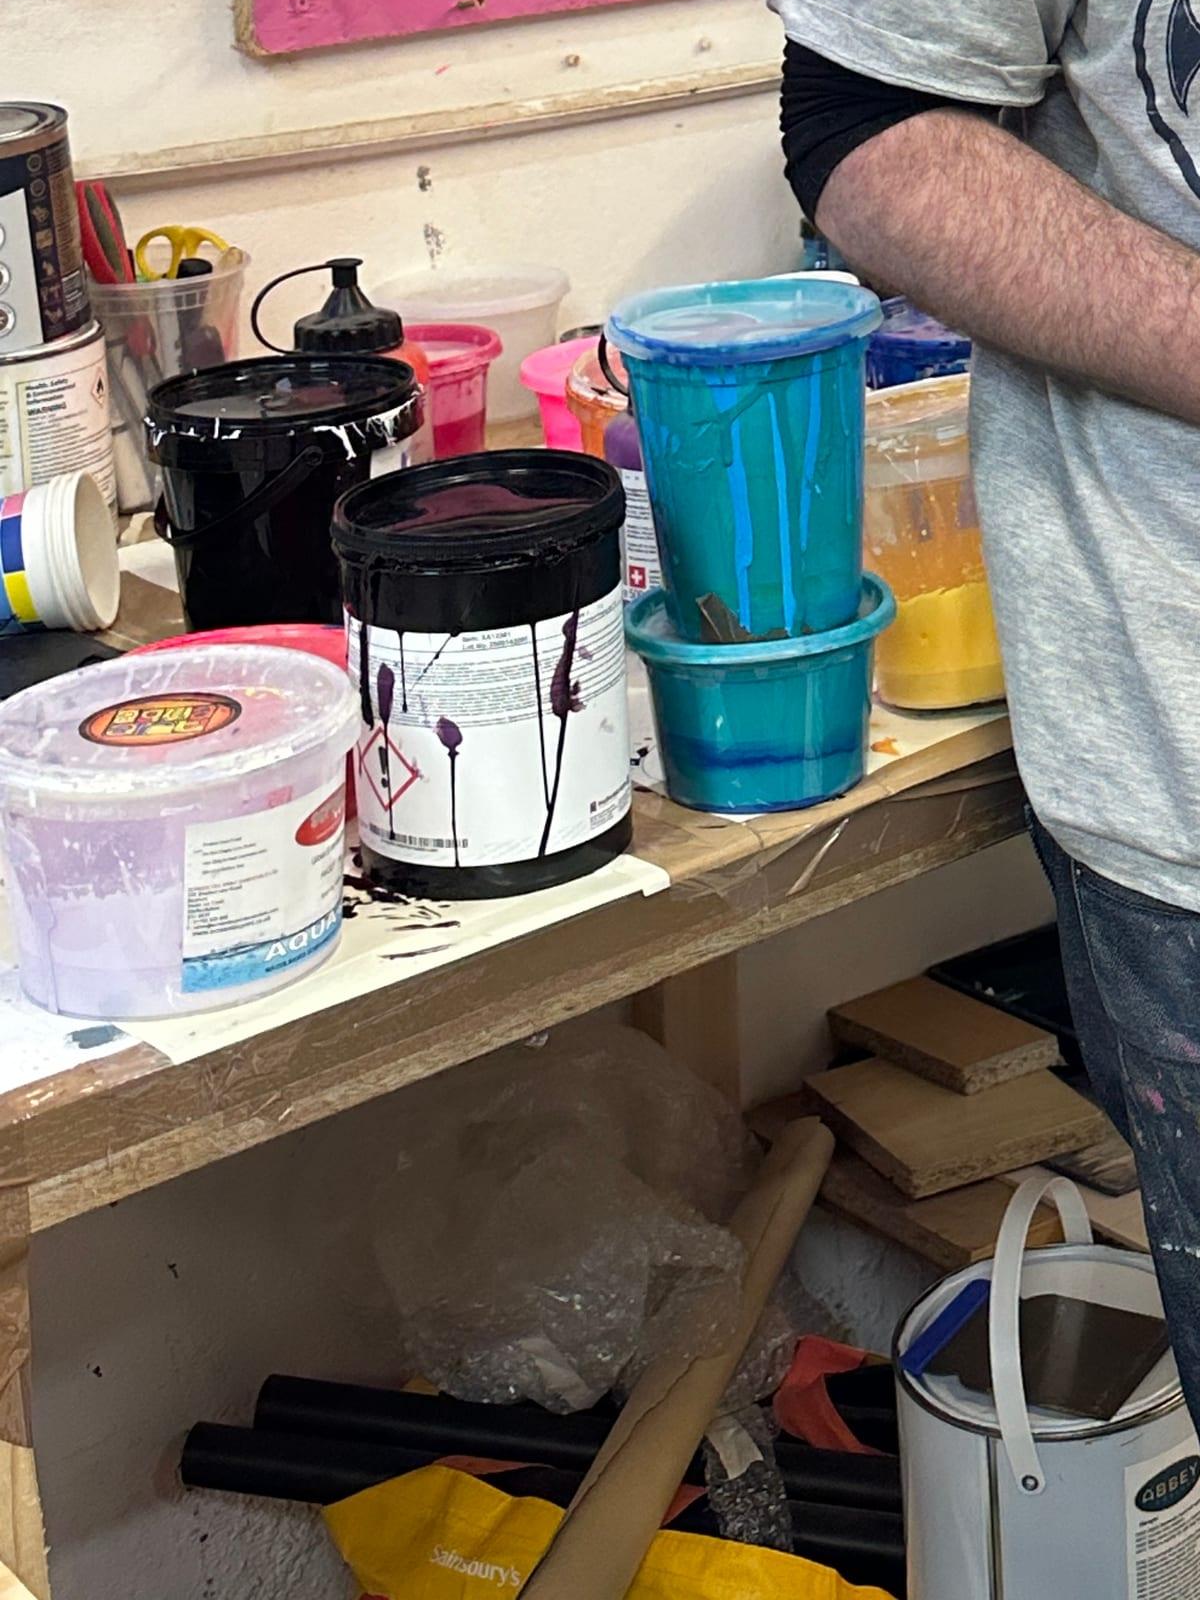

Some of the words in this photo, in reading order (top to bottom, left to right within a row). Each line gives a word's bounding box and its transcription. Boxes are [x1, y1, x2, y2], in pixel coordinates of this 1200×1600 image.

[264, 911, 337, 962] AQUA
[1142, 1461, 1199, 1504] ABBEY
[431, 1544, 521, 1587] Sainsbury's
